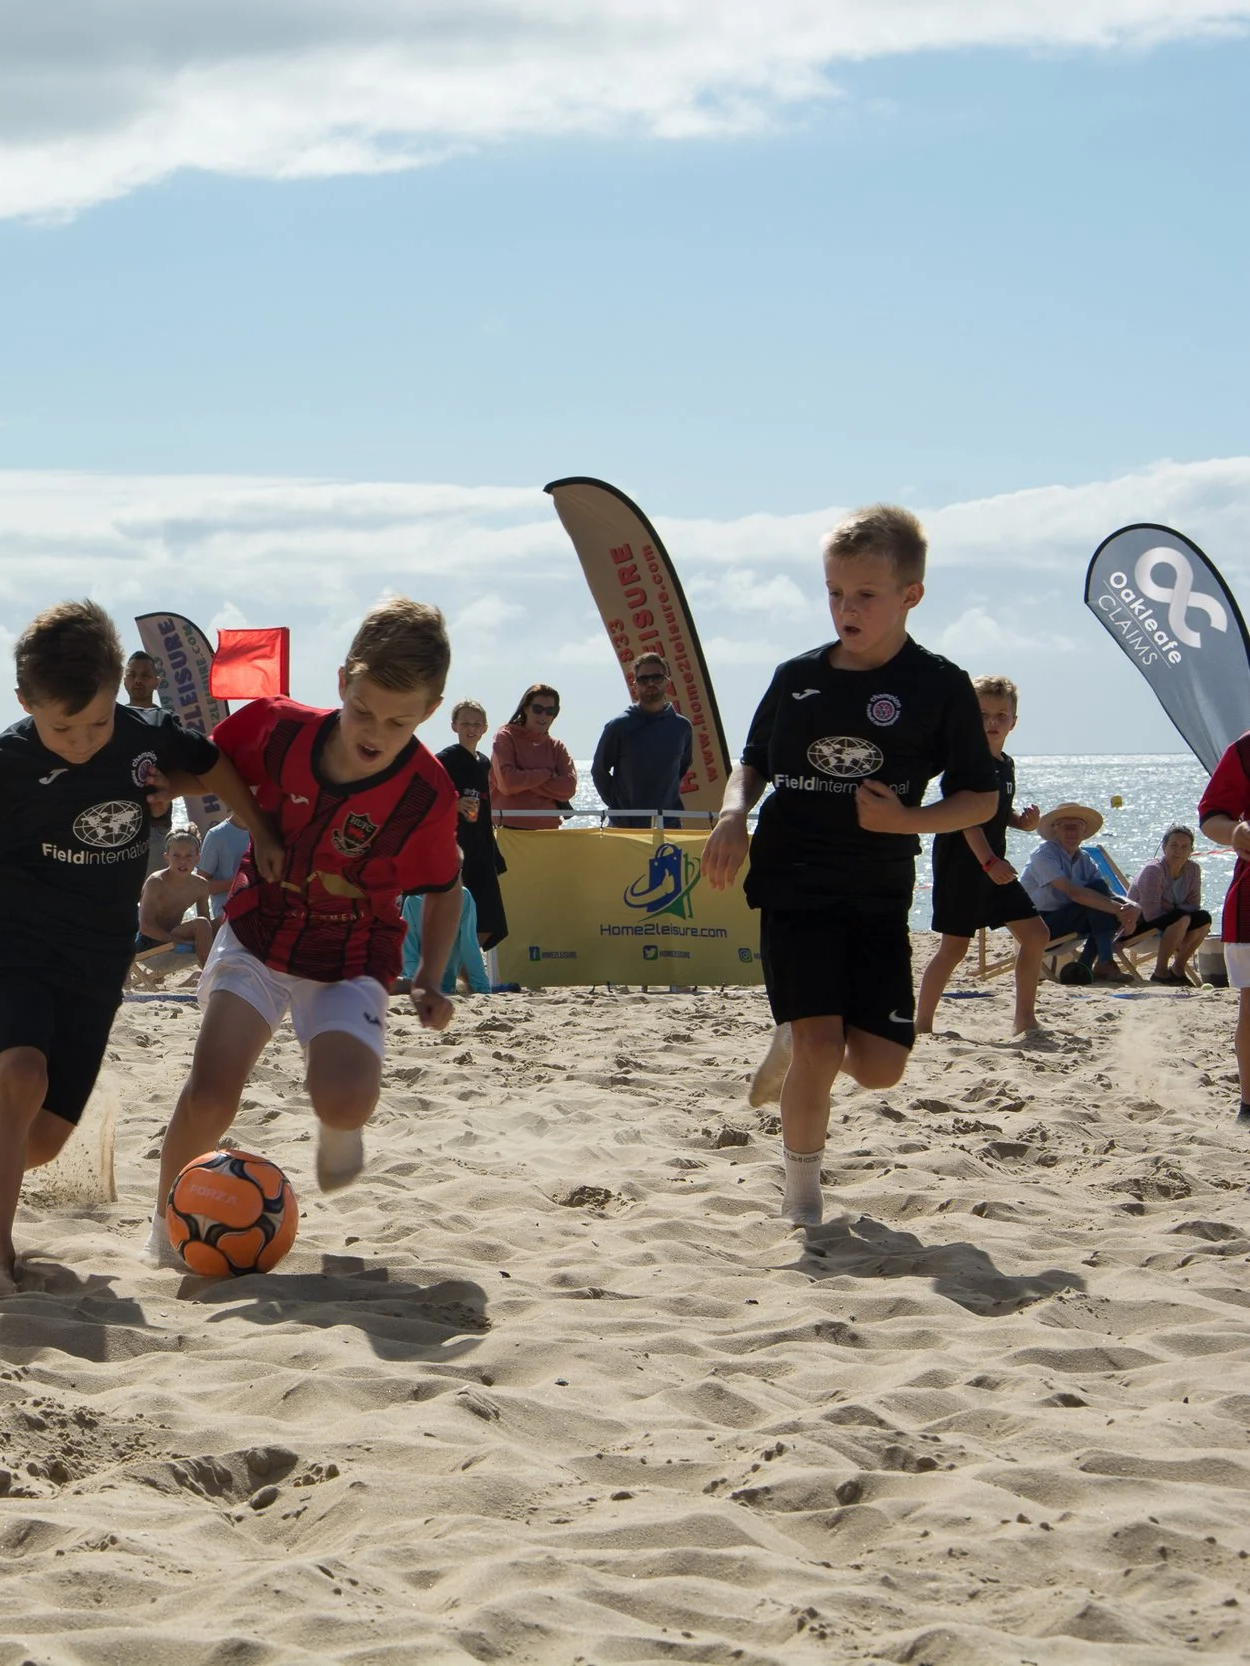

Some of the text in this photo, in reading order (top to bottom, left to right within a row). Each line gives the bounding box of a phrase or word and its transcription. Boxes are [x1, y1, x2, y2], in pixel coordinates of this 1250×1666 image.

[1110, 572, 1182, 664] Oakleafe
[1098, 595, 1158, 665] CLAIMS
[773, 773, 910, 796] FieldInternnal
[599, 923, 728, 939] Home2leisure.com
[189, 1184, 238, 1205] FORZA
